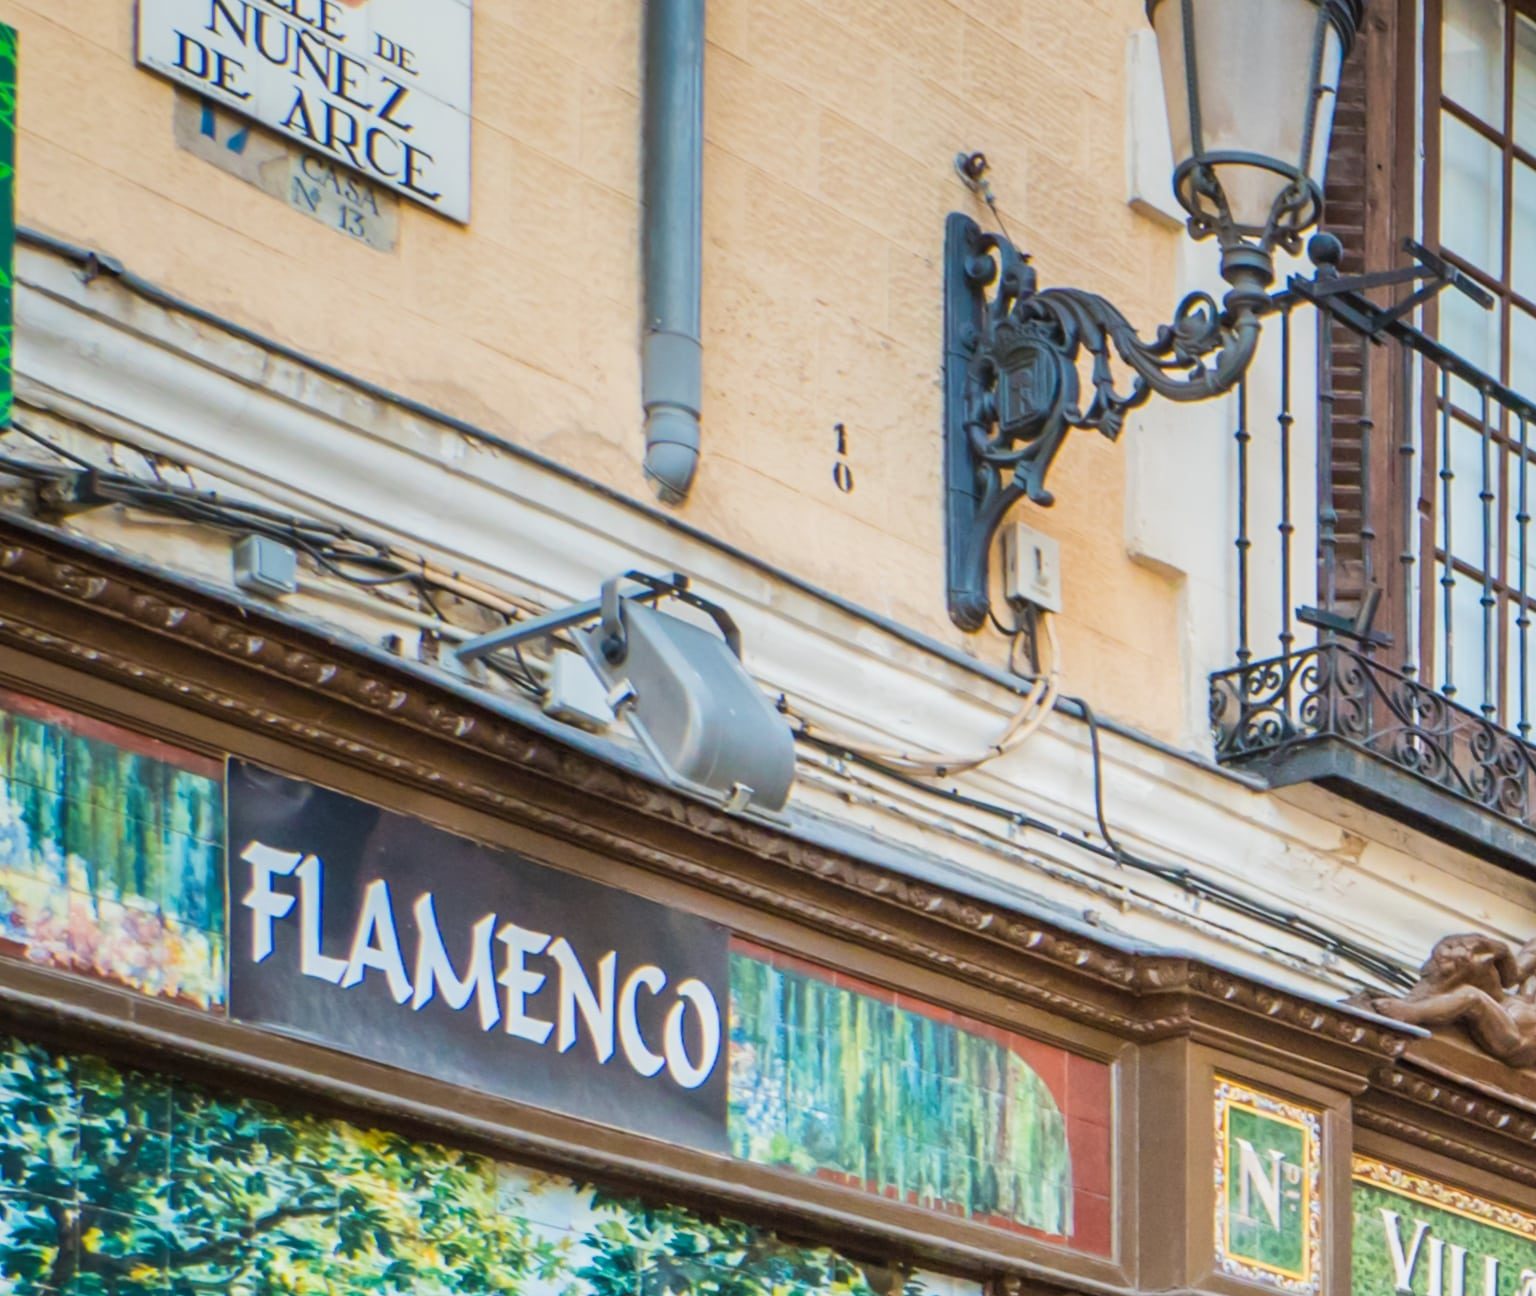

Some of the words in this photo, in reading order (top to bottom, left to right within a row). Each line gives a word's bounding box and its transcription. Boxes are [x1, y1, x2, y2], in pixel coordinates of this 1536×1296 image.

[172, 28, 252, 100] DE
[374, 31, 419, 76] DE
[279, 85, 443, 201] ARCE
[301, 153, 380, 216] CASA
[239, 839, 723, 1089] FLAMENCO
